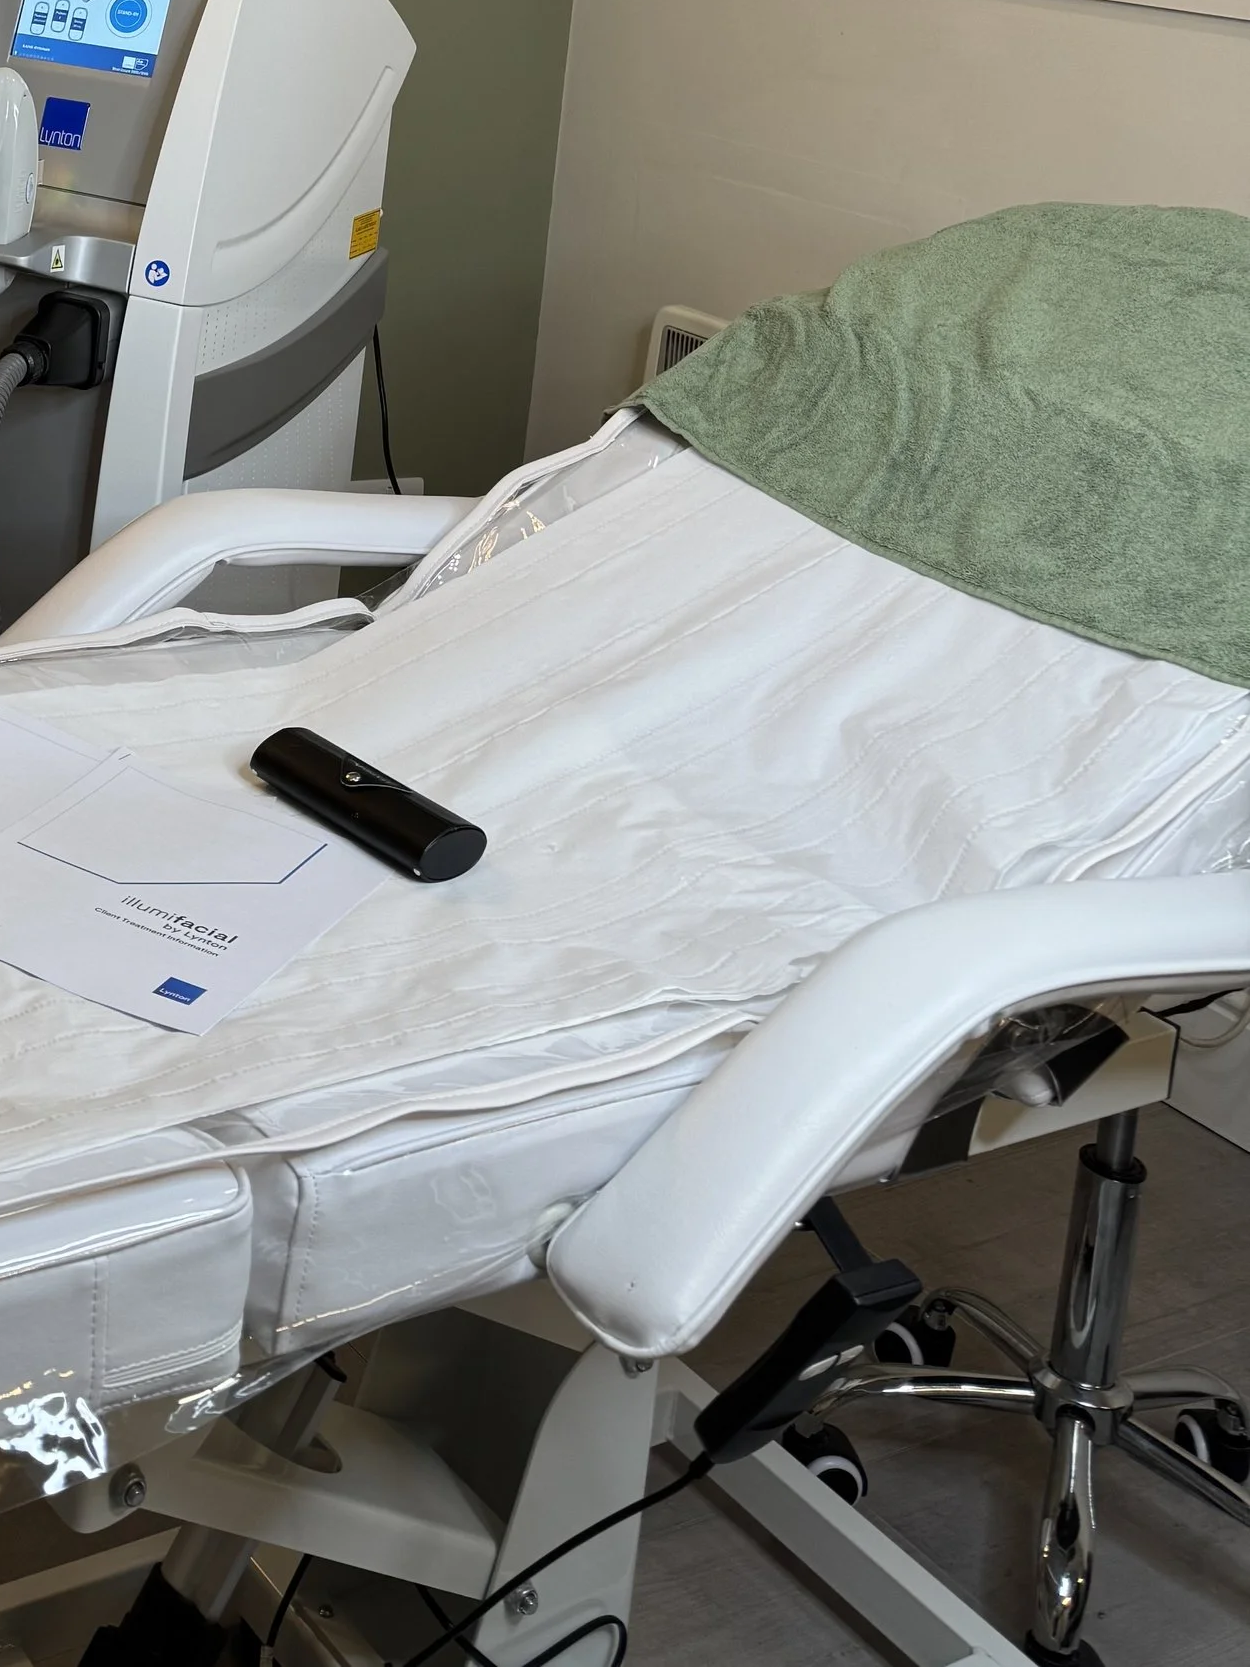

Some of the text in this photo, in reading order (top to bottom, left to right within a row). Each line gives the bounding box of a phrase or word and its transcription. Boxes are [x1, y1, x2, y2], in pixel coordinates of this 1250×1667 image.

[94, 907, 219, 957] Client Treatment Information
[121, 895, 239, 944] illumifacial
[162, 923, 228, 952] by Lynton
[159, 987, 191, 1003] Lynton
